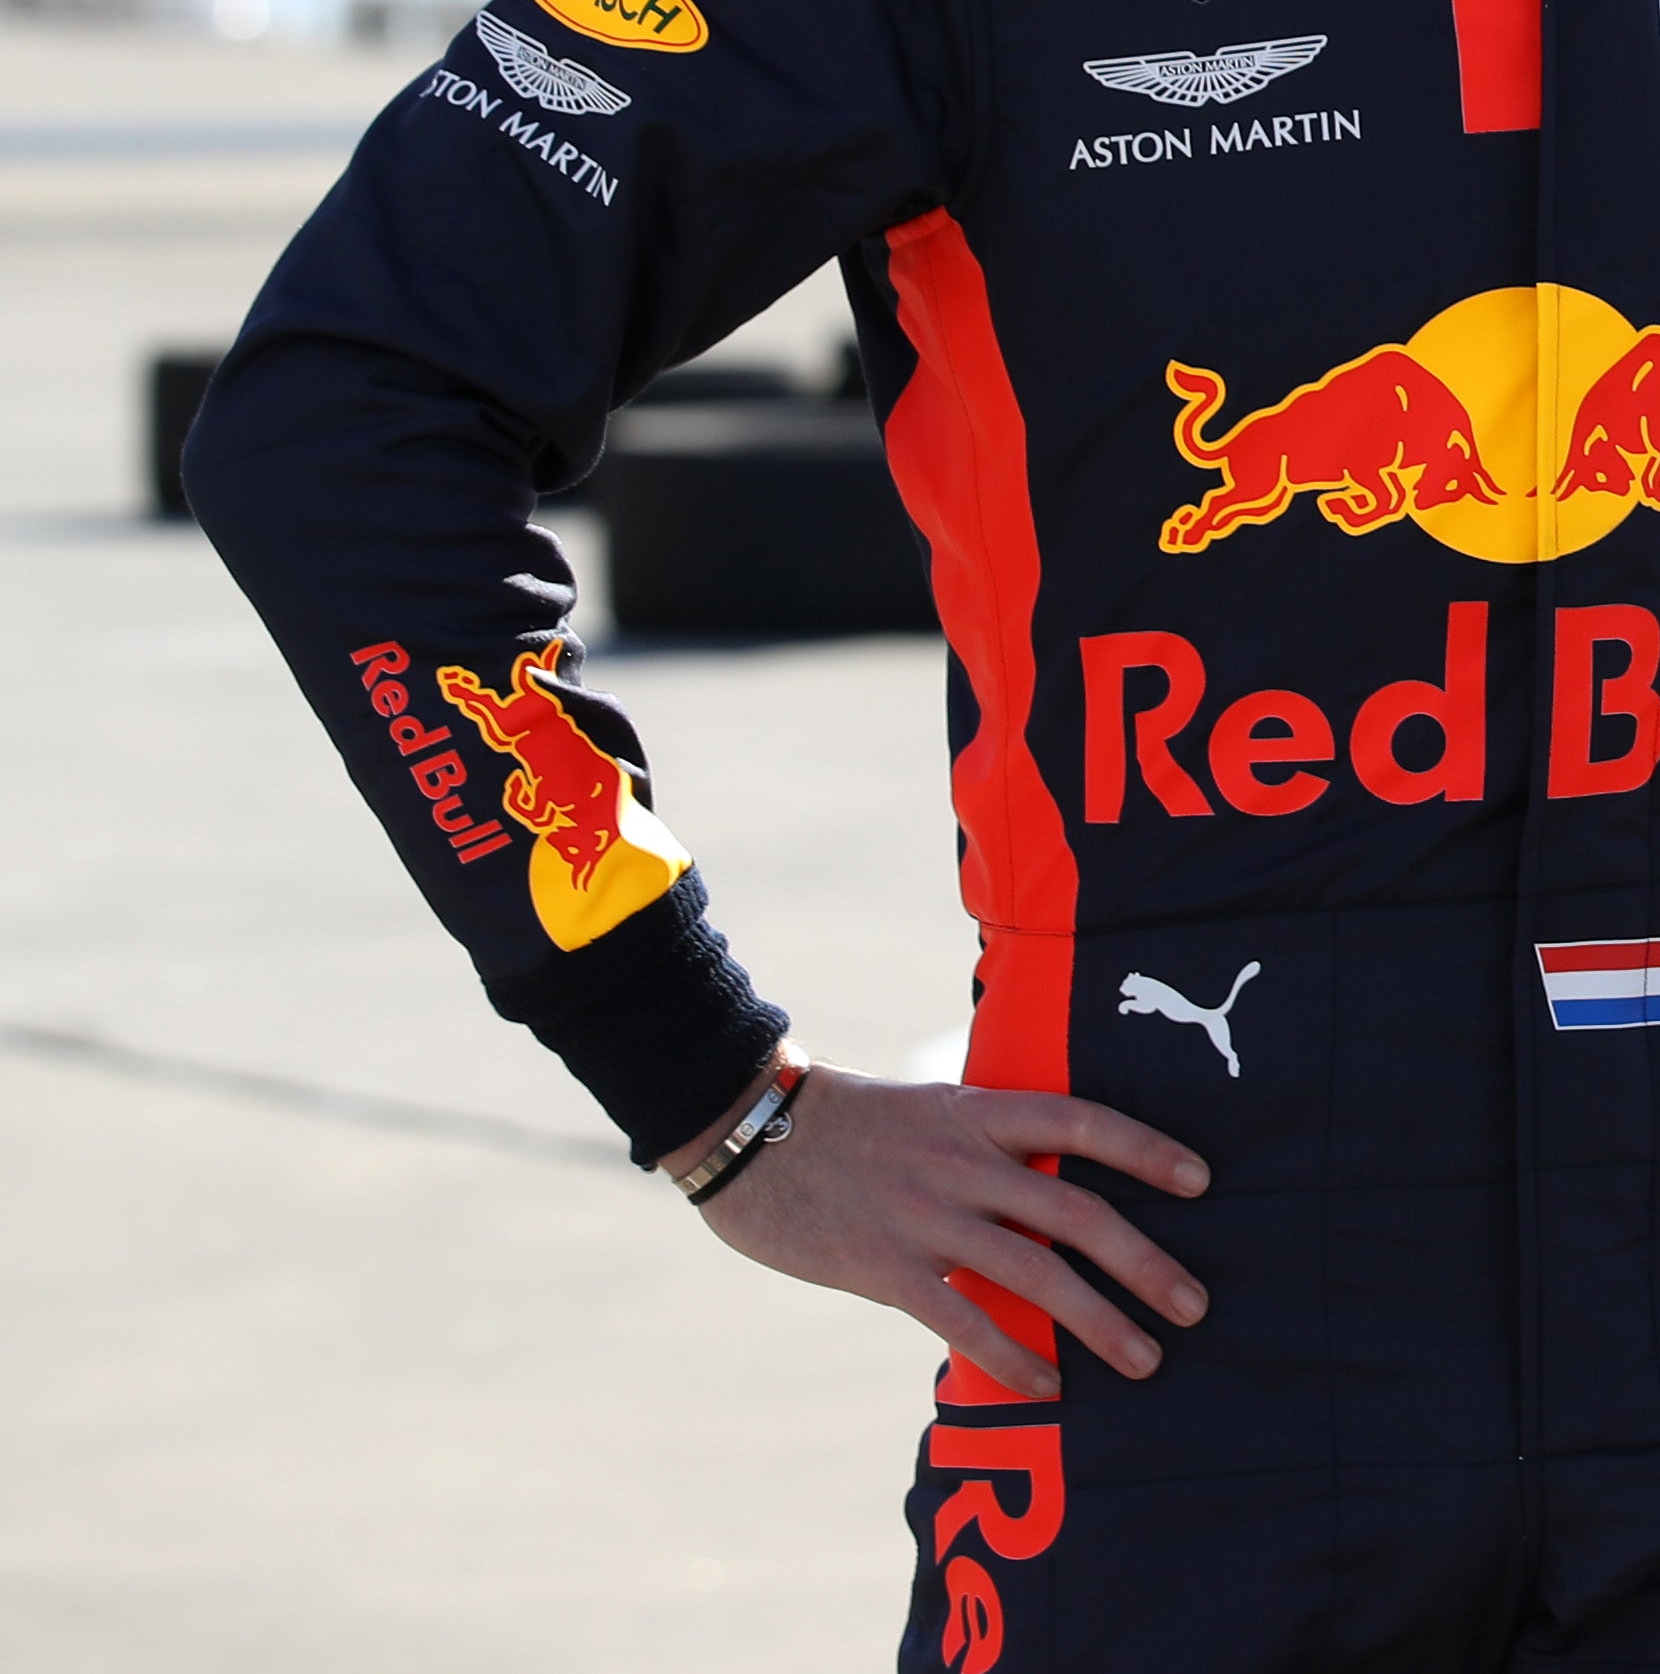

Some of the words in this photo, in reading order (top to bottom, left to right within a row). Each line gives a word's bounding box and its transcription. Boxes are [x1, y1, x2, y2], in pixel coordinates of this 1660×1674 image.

[418, 69, 504, 119] STON
[499, 111, 619, 207] MARTIN
[1069, 129, 1193, 171] ASTON
[1210, 109, 1363, 155] MARTIN
[1160, 61, 1203, 78] ASTON
[1203, 54, 1257, 75] MARTIN
[349, 639, 453, 757] Red
[409, 748, 513, 865] Bull
[1079, 600, 1489, 824] Red
[929, 1423, 1067, 1674] Re
